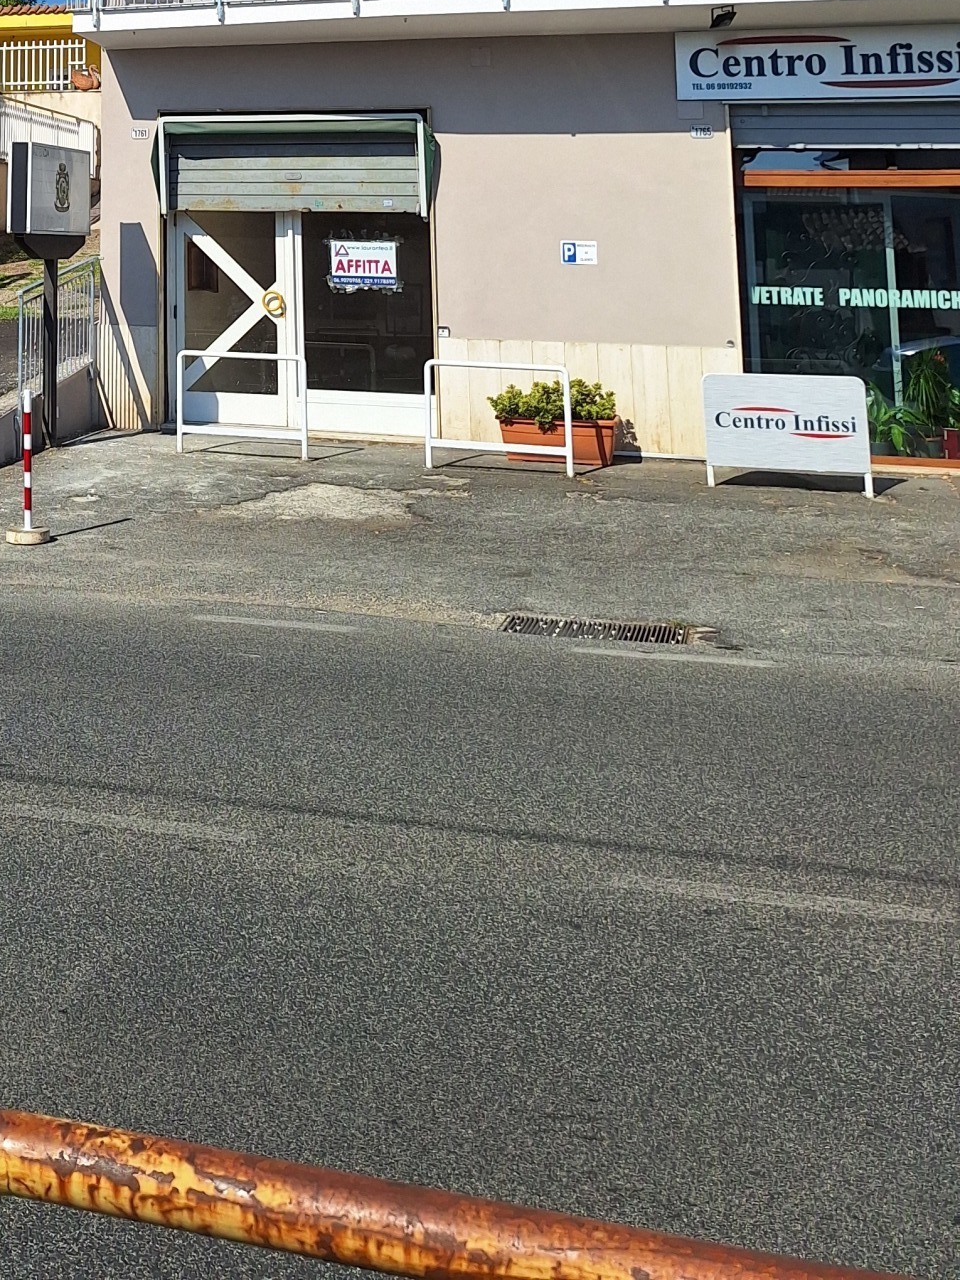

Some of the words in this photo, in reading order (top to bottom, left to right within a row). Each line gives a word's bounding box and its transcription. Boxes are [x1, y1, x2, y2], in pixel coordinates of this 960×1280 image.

[689, 47, 827, 78] Centro
[135, 129, 147, 137] 1761
[694, 127, 712, 136] 1765
[564, 244, 574, 261] P
[335, 259, 392, 274] AFFITTA
[751, 286, 824, 306] VETRATE
[839, 288, 960, 309] PANORAMICH
[715, 411, 786, 430] Centro
[794, 414, 857, 433] Infissi
